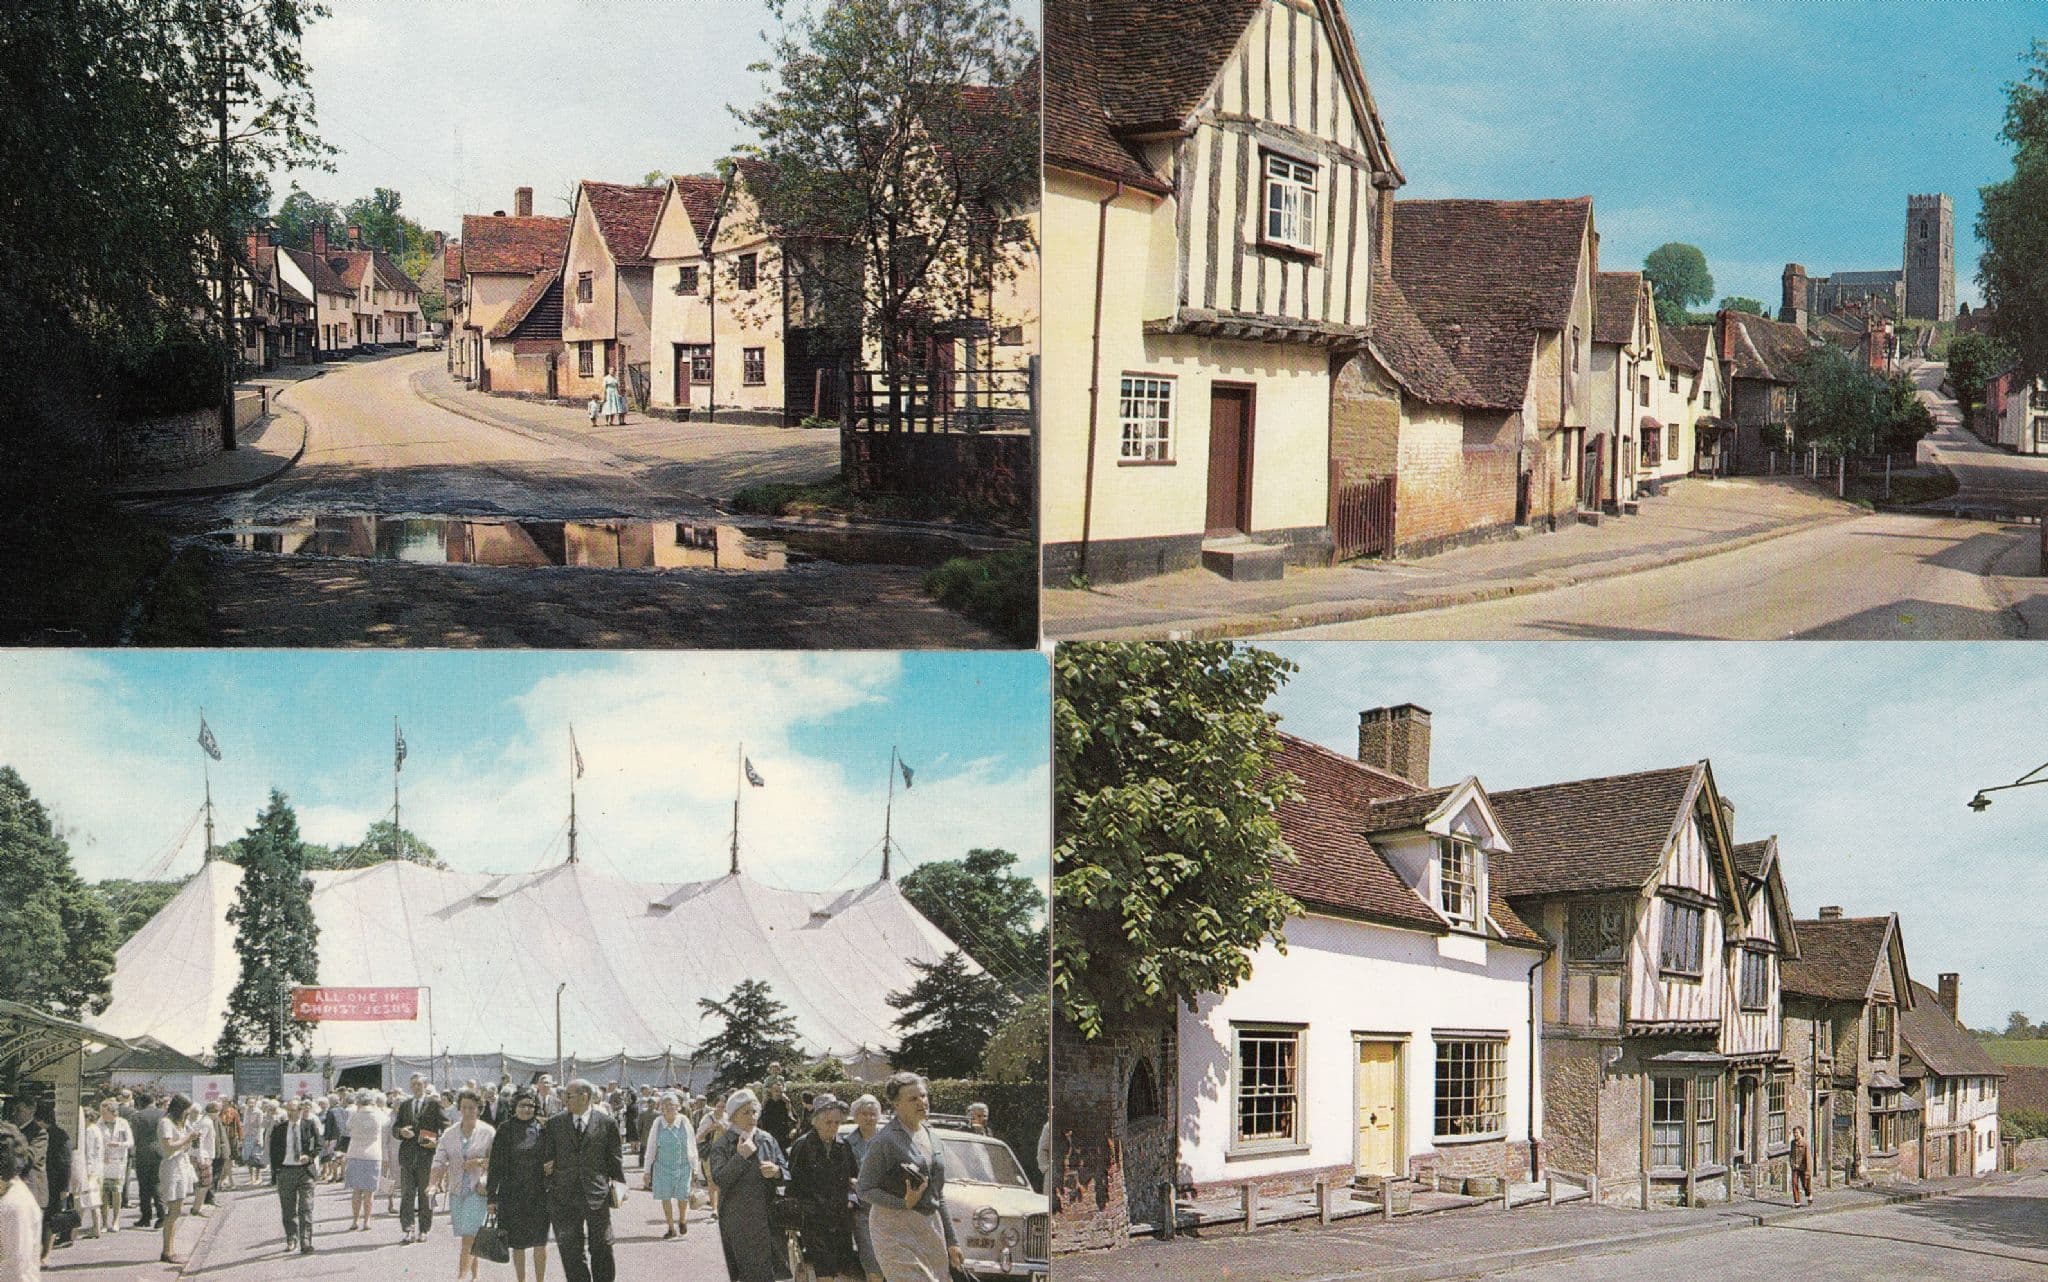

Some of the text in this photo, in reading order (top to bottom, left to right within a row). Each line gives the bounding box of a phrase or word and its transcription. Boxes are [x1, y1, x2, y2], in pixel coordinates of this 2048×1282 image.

[315, 990, 400, 1002] ALL ONE IN
[301, 1002, 412, 1015] CHRIST JESUS
